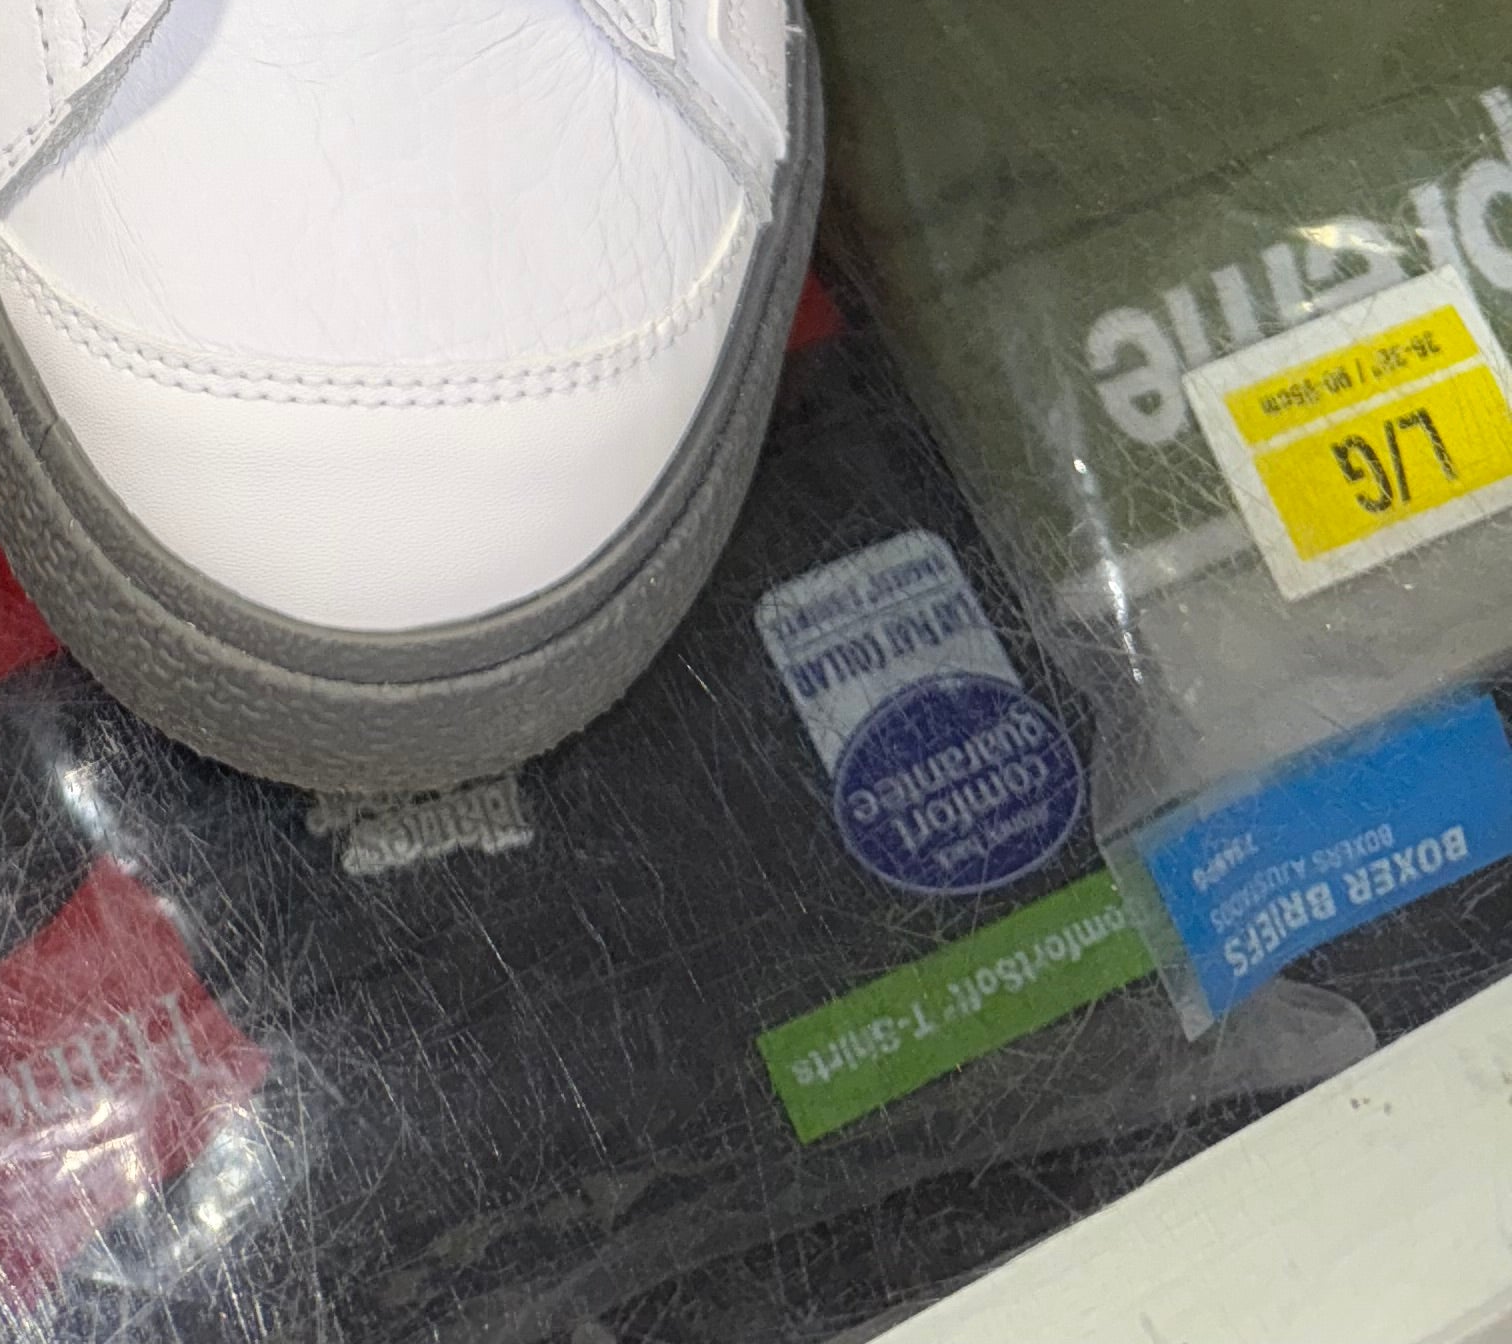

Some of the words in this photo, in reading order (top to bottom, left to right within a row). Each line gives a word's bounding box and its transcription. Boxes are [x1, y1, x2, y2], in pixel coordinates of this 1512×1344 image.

[1331, 408, 1458, 514] L/G
[848, 703, 1046, 824] guarantee
[890, 754, 1048, 848] comfort
[1342, 826, 1468, 905] BOXER
[1224, 881, 1336, 977] BRIEFS
[791, 1001, 936, 1086] T-Shirts
